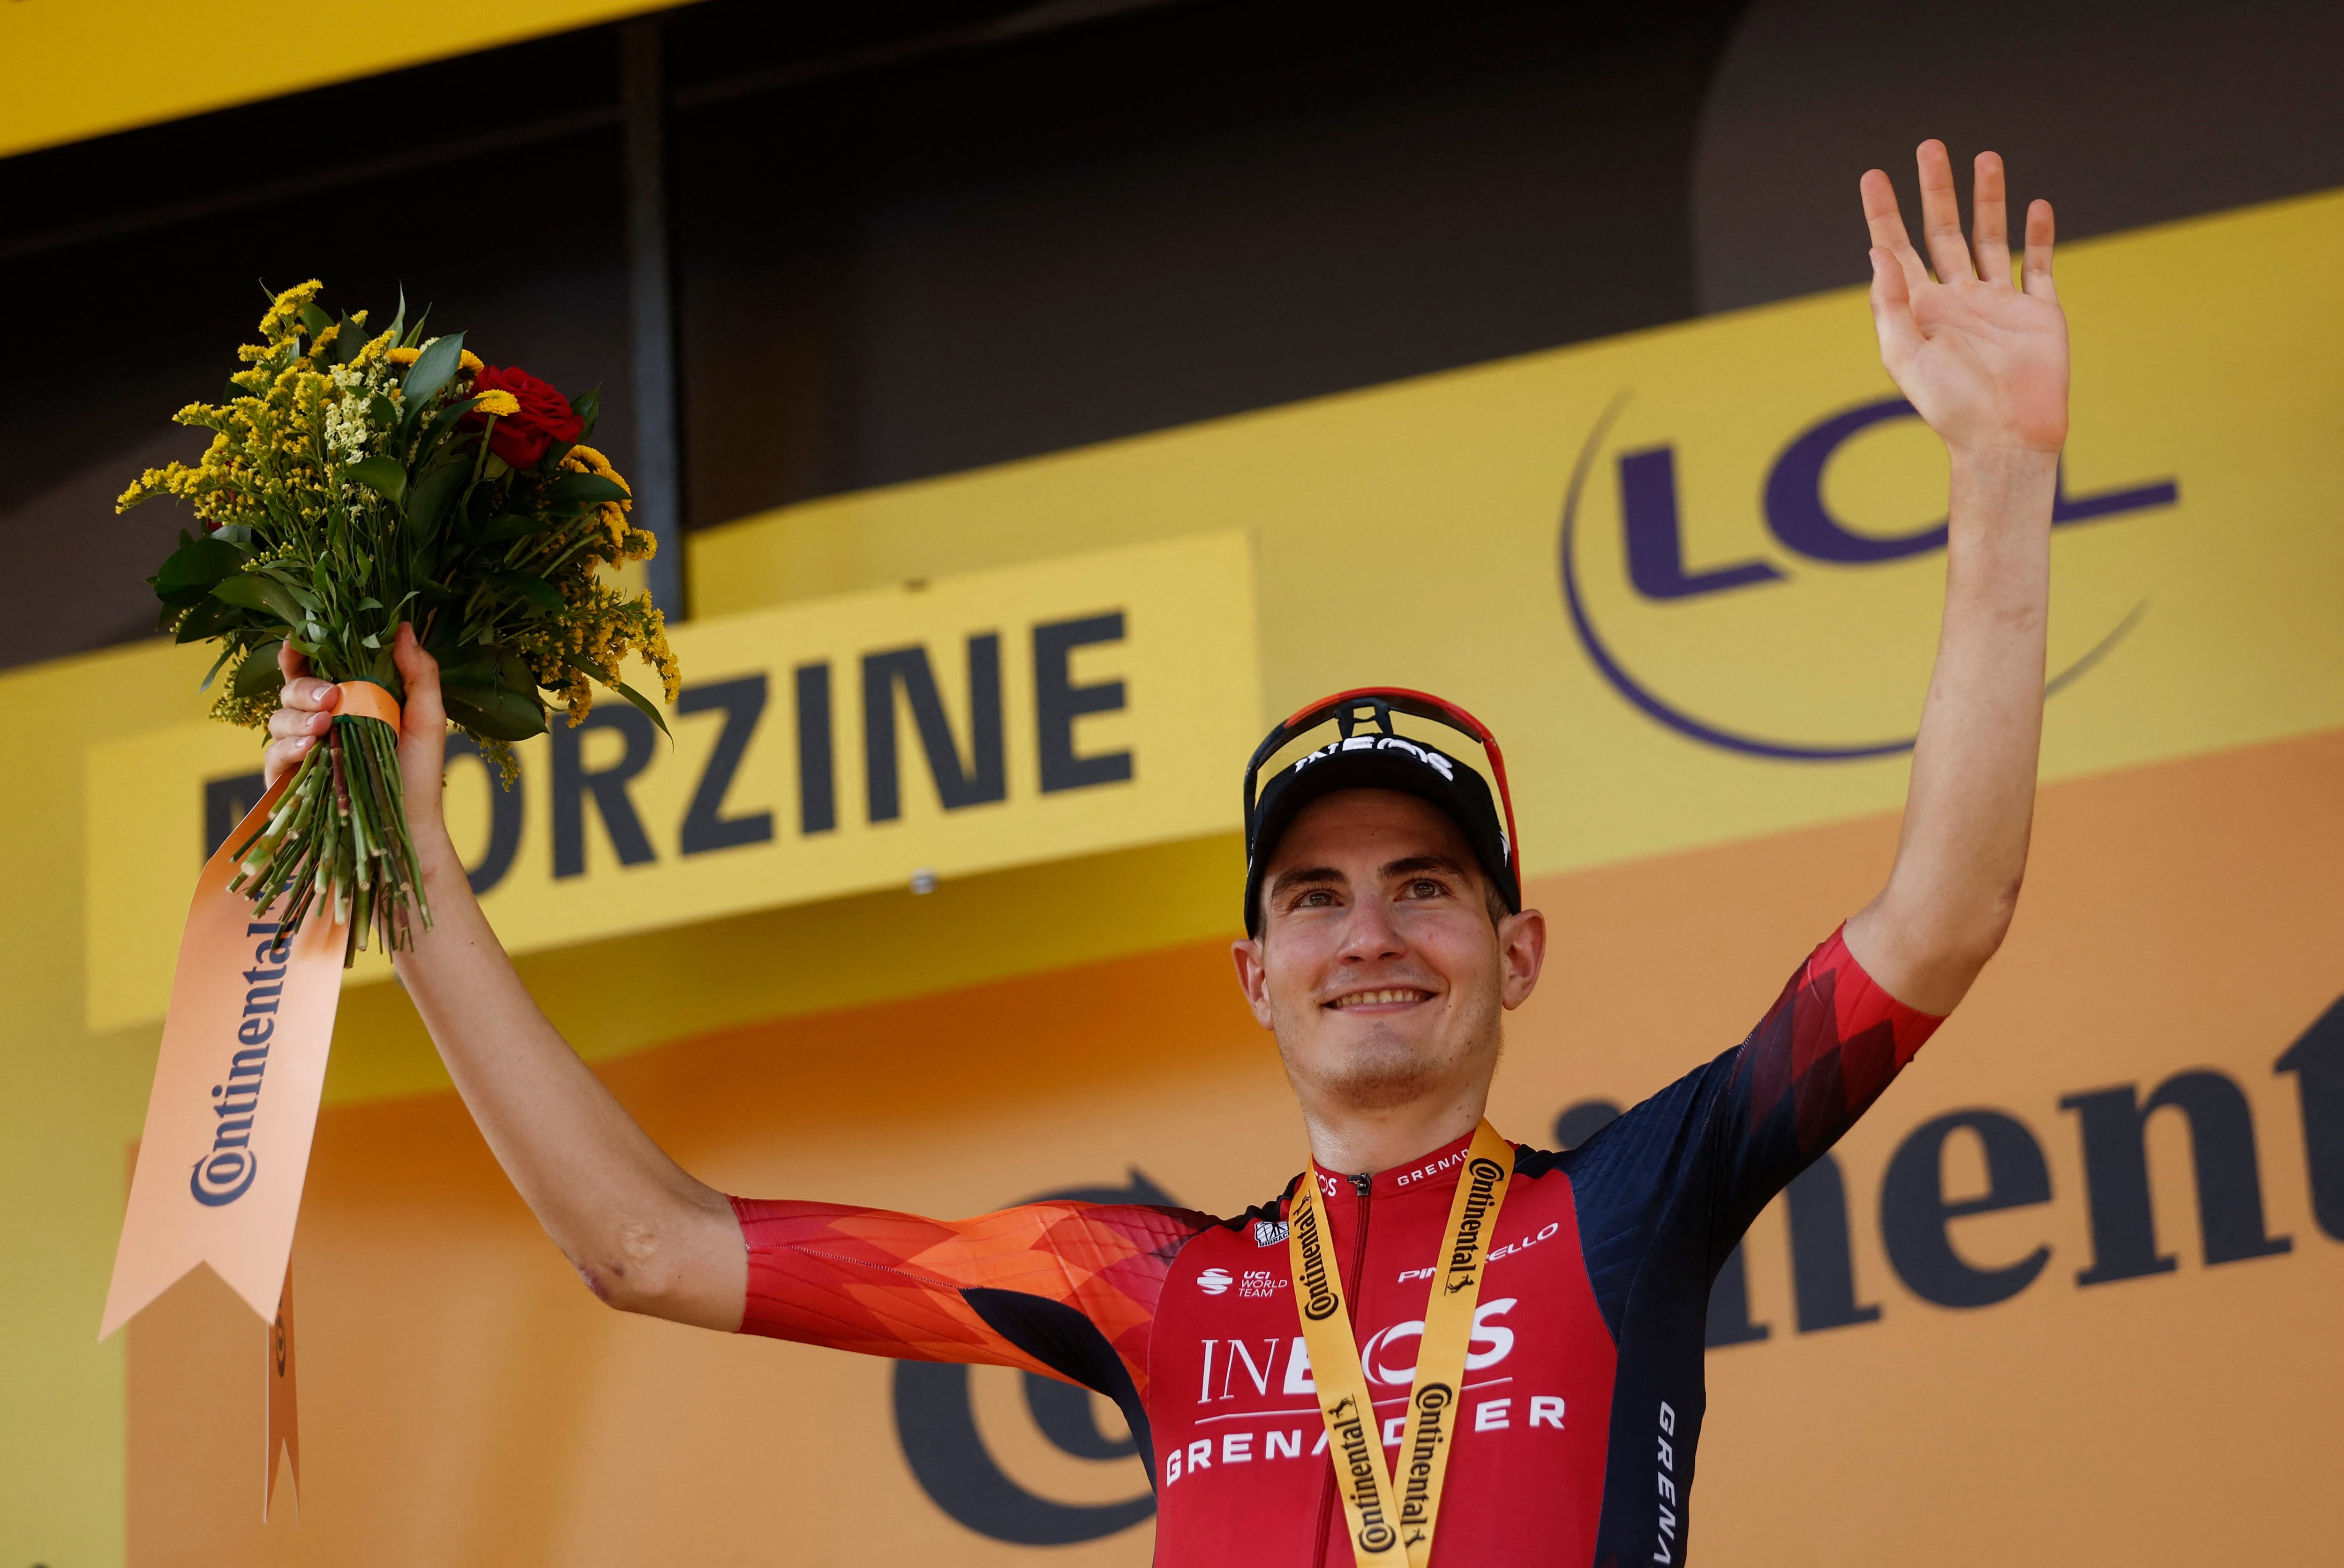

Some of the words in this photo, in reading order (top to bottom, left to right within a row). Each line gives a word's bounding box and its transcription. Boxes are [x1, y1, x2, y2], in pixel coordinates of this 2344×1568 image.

[202, 608, 1133, 896] ORZINE
[190, 920, 295, 1208] Continental
[1259, 1230, 1290, 1247] BIORAC
[1315, 1170, 1337, 1197] OS
[1450, 1157, 1505, 1274] Continental
[1238, 1288, 1273, 1297] TEAM
[1241, 1279, 1288, 1288] WORLD
[1243, 1271, 1271, 1279] UCI
[1293, 1205, 1339, 1320] Continental
[1197, 1298, 1518, 1404] INEOS
[1333, 1415, 1396, 1553] Continental
[1401, 1382, 1452, 1526] Continental
[1653, 1400, 1676, 1568] GRENA
